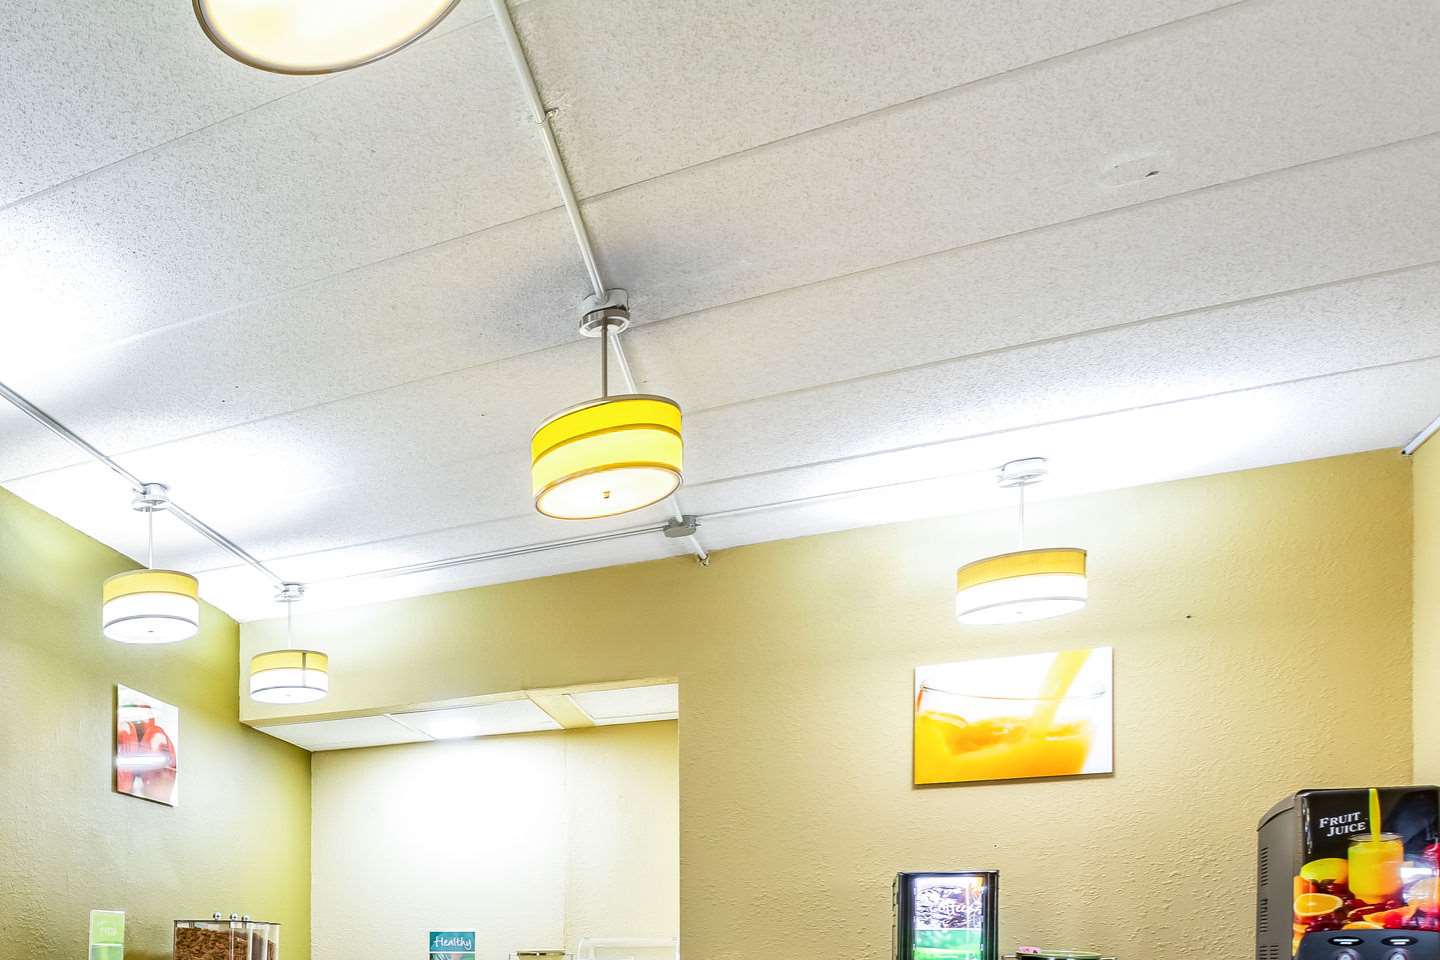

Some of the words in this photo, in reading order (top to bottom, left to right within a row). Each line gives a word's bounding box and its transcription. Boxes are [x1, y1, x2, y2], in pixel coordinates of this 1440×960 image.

[1319, 811, 1361, 828] FRUIT
[1326, 821, 1367, 837] JUICE
[433, 936, 472, 951] Healthy
